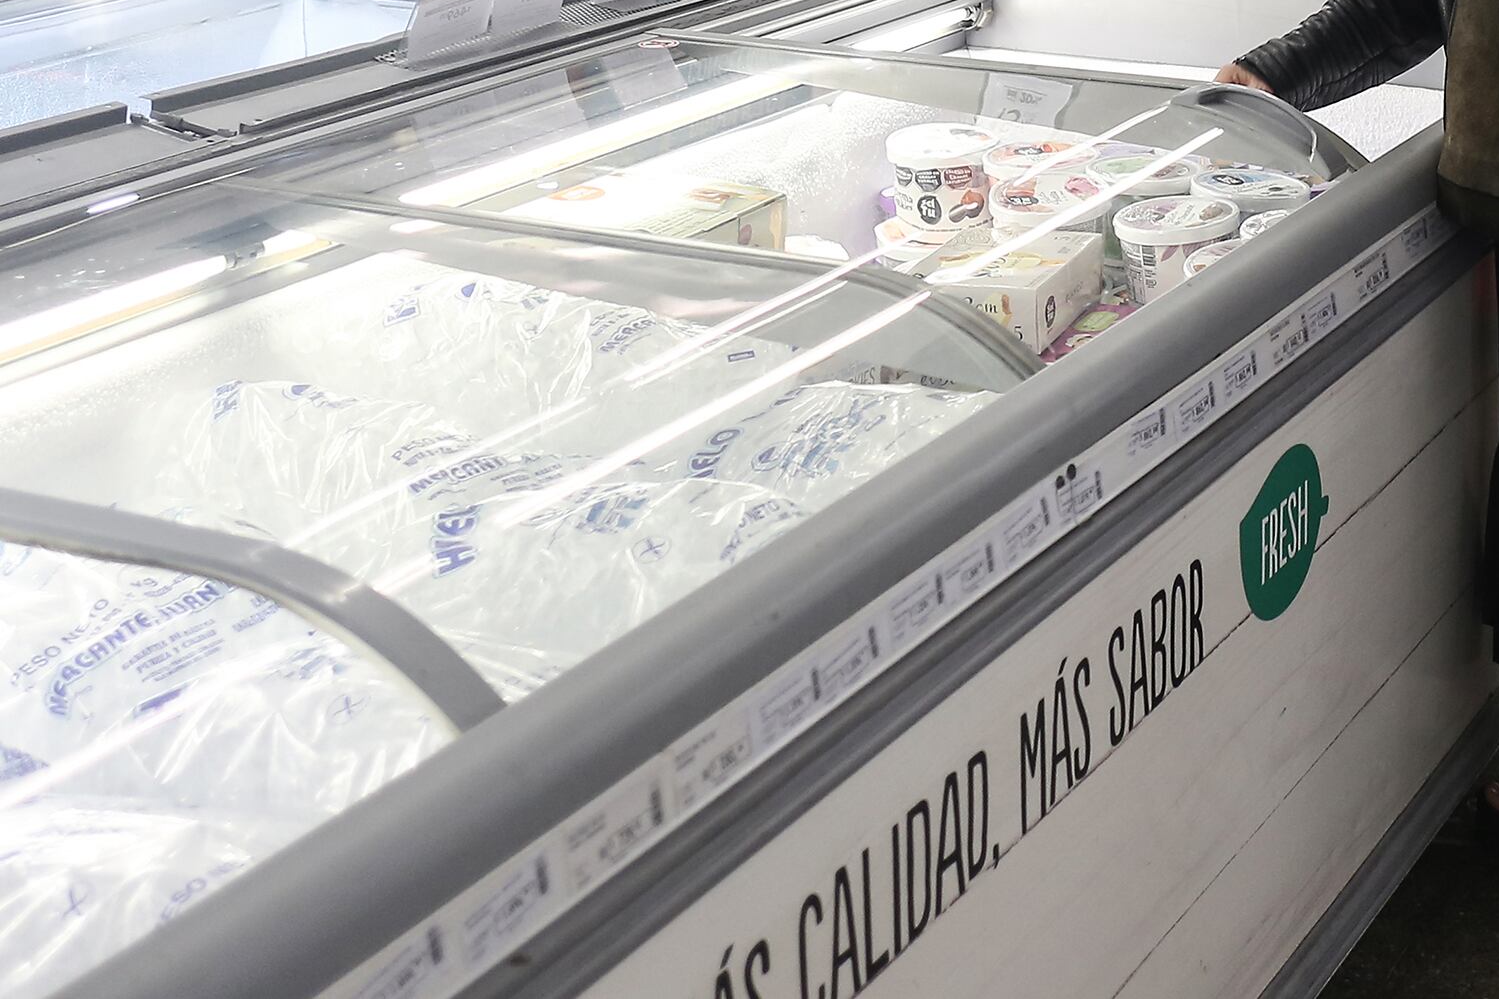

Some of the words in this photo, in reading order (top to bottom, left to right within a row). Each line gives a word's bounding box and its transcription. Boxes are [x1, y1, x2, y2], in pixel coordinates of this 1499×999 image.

[689, 428, 741, 478] IELO
[1260, 479, 1310, 587] FRESH
[1018, 656, 1092, 837] MÁS
[1106, 558, 1205, 746] SABOR
